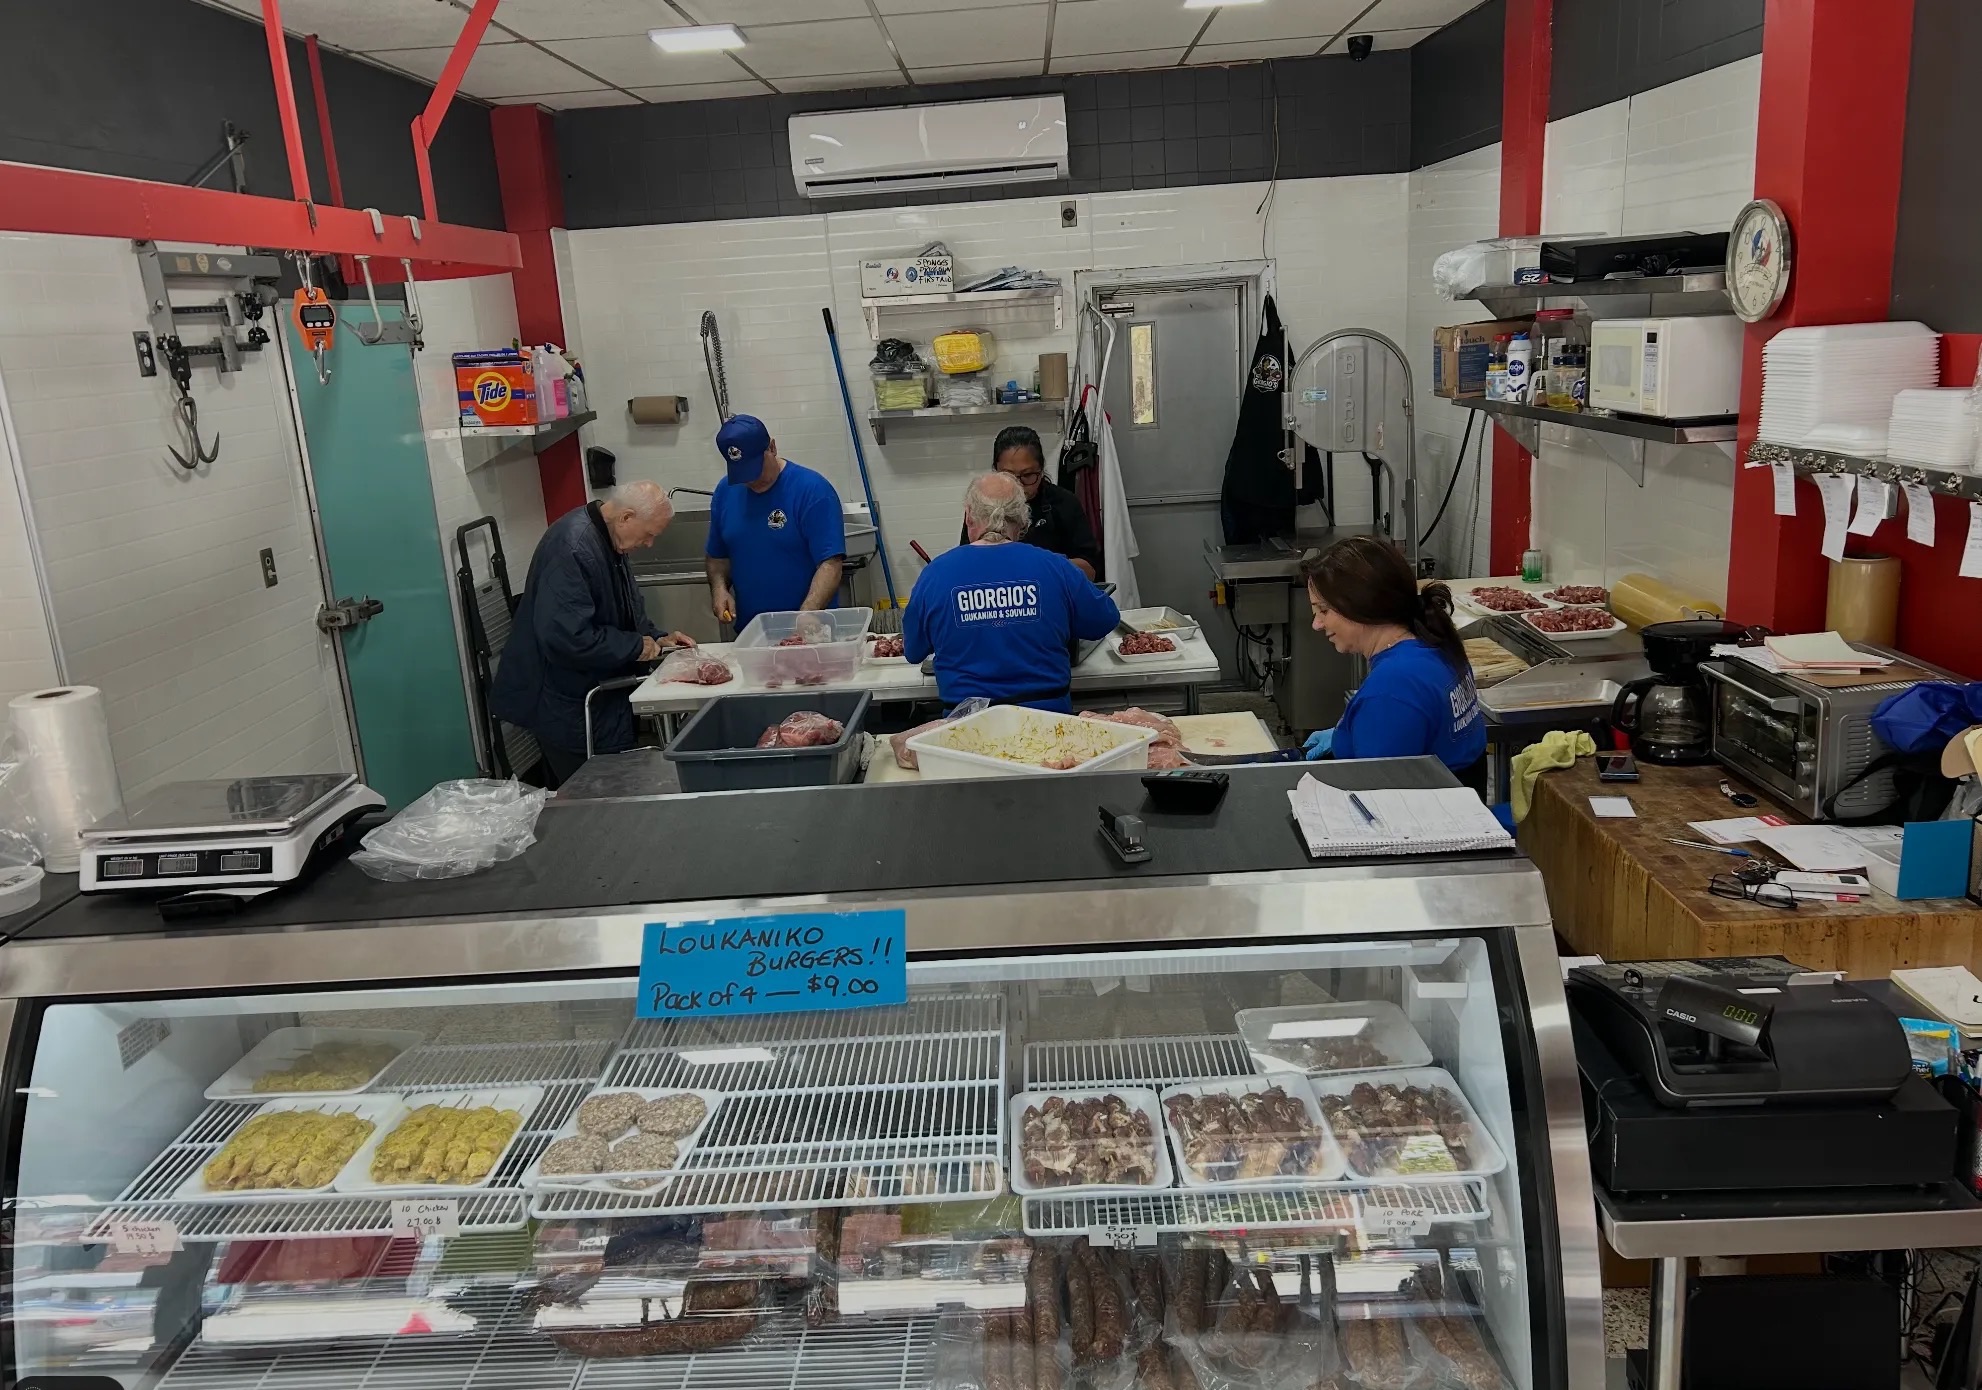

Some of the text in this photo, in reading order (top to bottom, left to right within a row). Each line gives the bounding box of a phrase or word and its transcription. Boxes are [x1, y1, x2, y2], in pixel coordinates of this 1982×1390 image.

[916, 258, 949, 267] SPONGES
[477, 380, 508, 405] Tide
[1343, 353, 1356, 443] BIRO
[957, 584, 1037, 611] GIORGIO'S
[961, 607, 1037, 622] LOUKANIKO & SOUVLAKI
[660, 927, 824, 955] LOUKANIKO
[650, 982, 703, 1012] Pack
[708, 983, 739, 1007] of
[739, 986, 759, 1005] 4
[807, 973, 879, 998] $9.00
[1666, 1008, 1697, 1023] CASIO
[1722, 1005, 1758, 1025] 0.00
[402, 1205, 411, 1213] 10
[1401, 1209, 1424, 1217] PORK
[122, 1224, 129, 1232] 5
